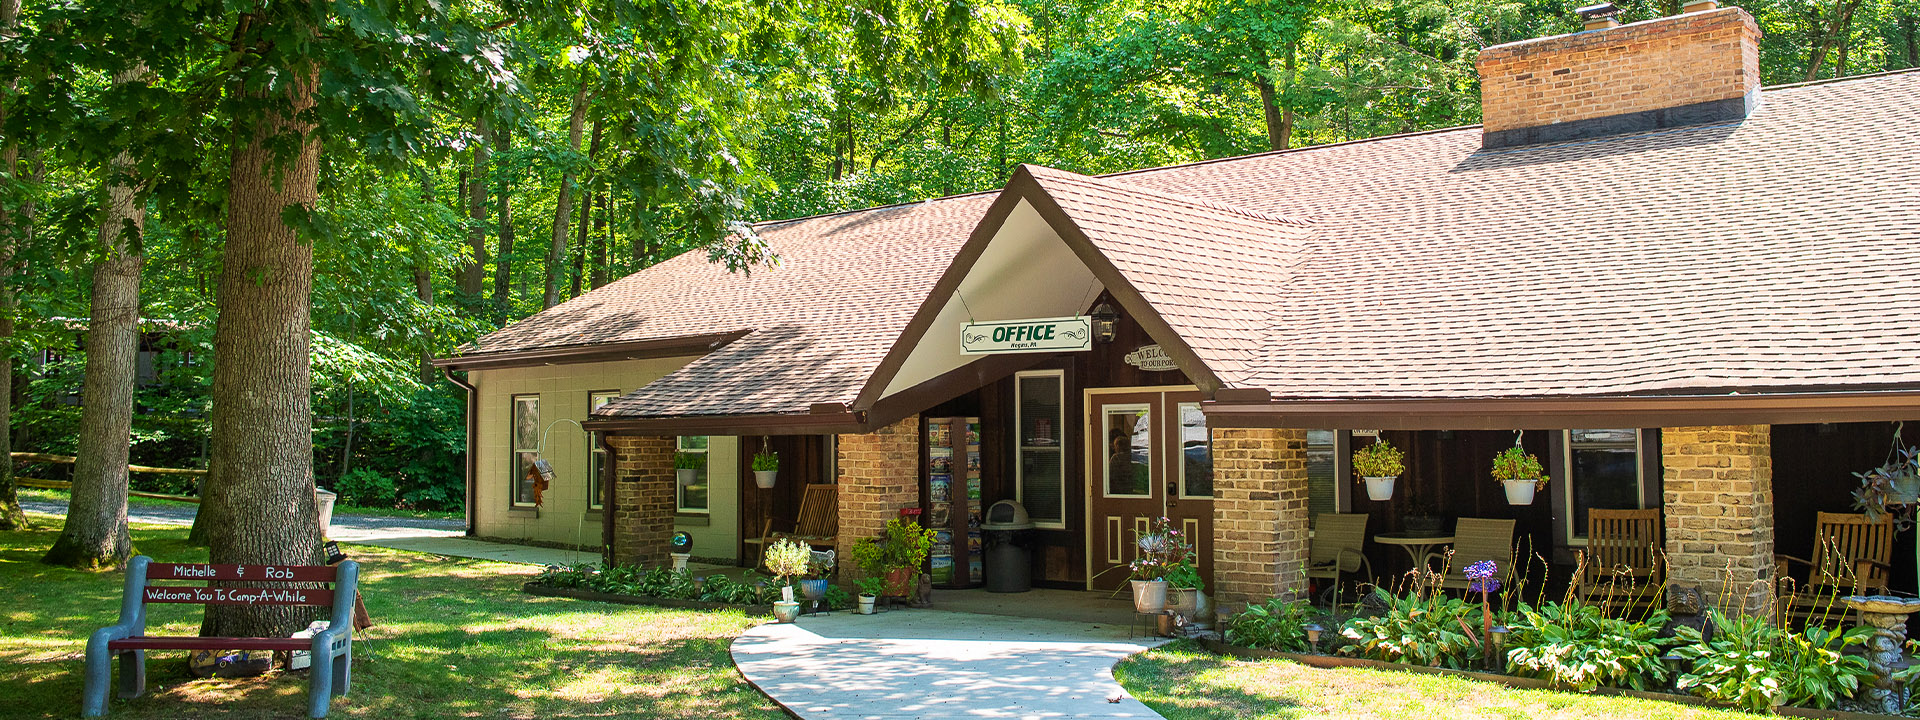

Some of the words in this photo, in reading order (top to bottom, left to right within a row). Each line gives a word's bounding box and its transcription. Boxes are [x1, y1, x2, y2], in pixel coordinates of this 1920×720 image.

[993, 325, 1056, 342] OFFICE
[173, 564, 216, 577] Michelle
[236, 564, 245, 578] &
[265, 566, 294, 579] Rob
[146, 588, 192, 601] Welcome
[193, 588, 213, 601] You
[214, 588, 226, 601] To
[228, 589, 306, 605] Camp-A-While
